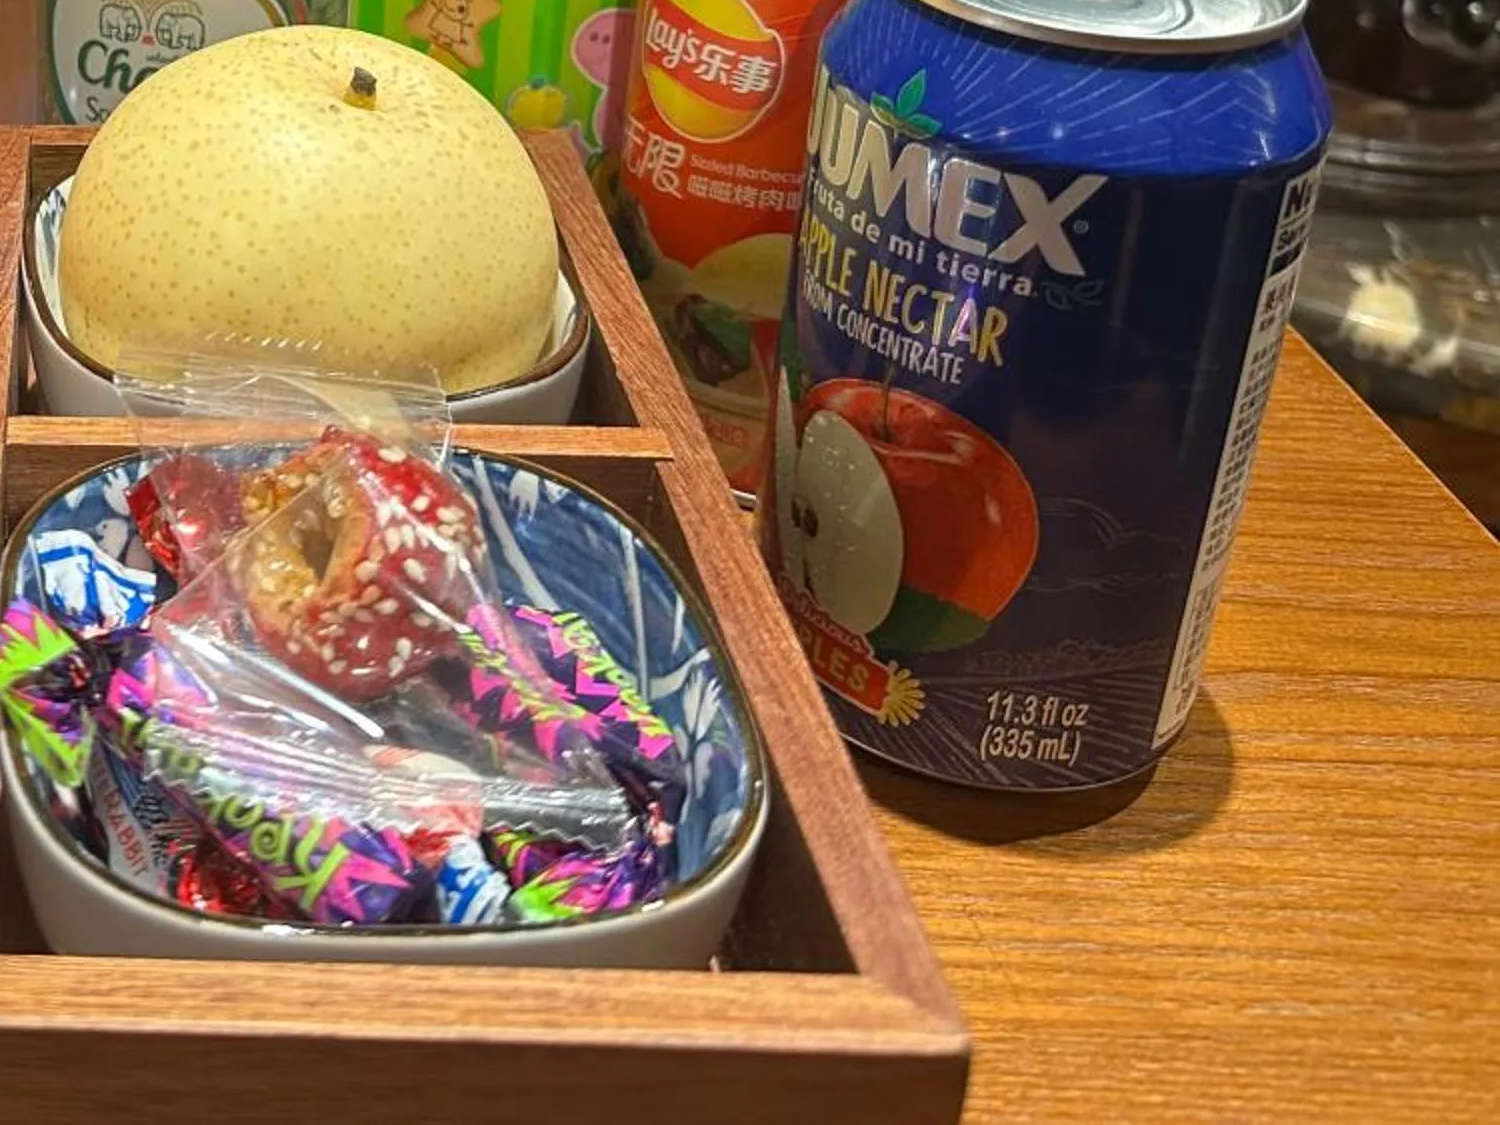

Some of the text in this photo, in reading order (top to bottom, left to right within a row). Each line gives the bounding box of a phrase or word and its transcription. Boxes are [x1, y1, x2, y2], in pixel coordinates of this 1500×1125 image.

[693, 44, 778, 94] 乐事
[851, 209, 882, 244] de
[888, 229, 927, 266] mi
[863, 258, 1010, 368] NECTAR
[836, 303, 966, 386] CONCENTRATE
[986, 689, 1090, 727] 11.3 fl oz
[978, 724, 1082, 768] (335 mL)
